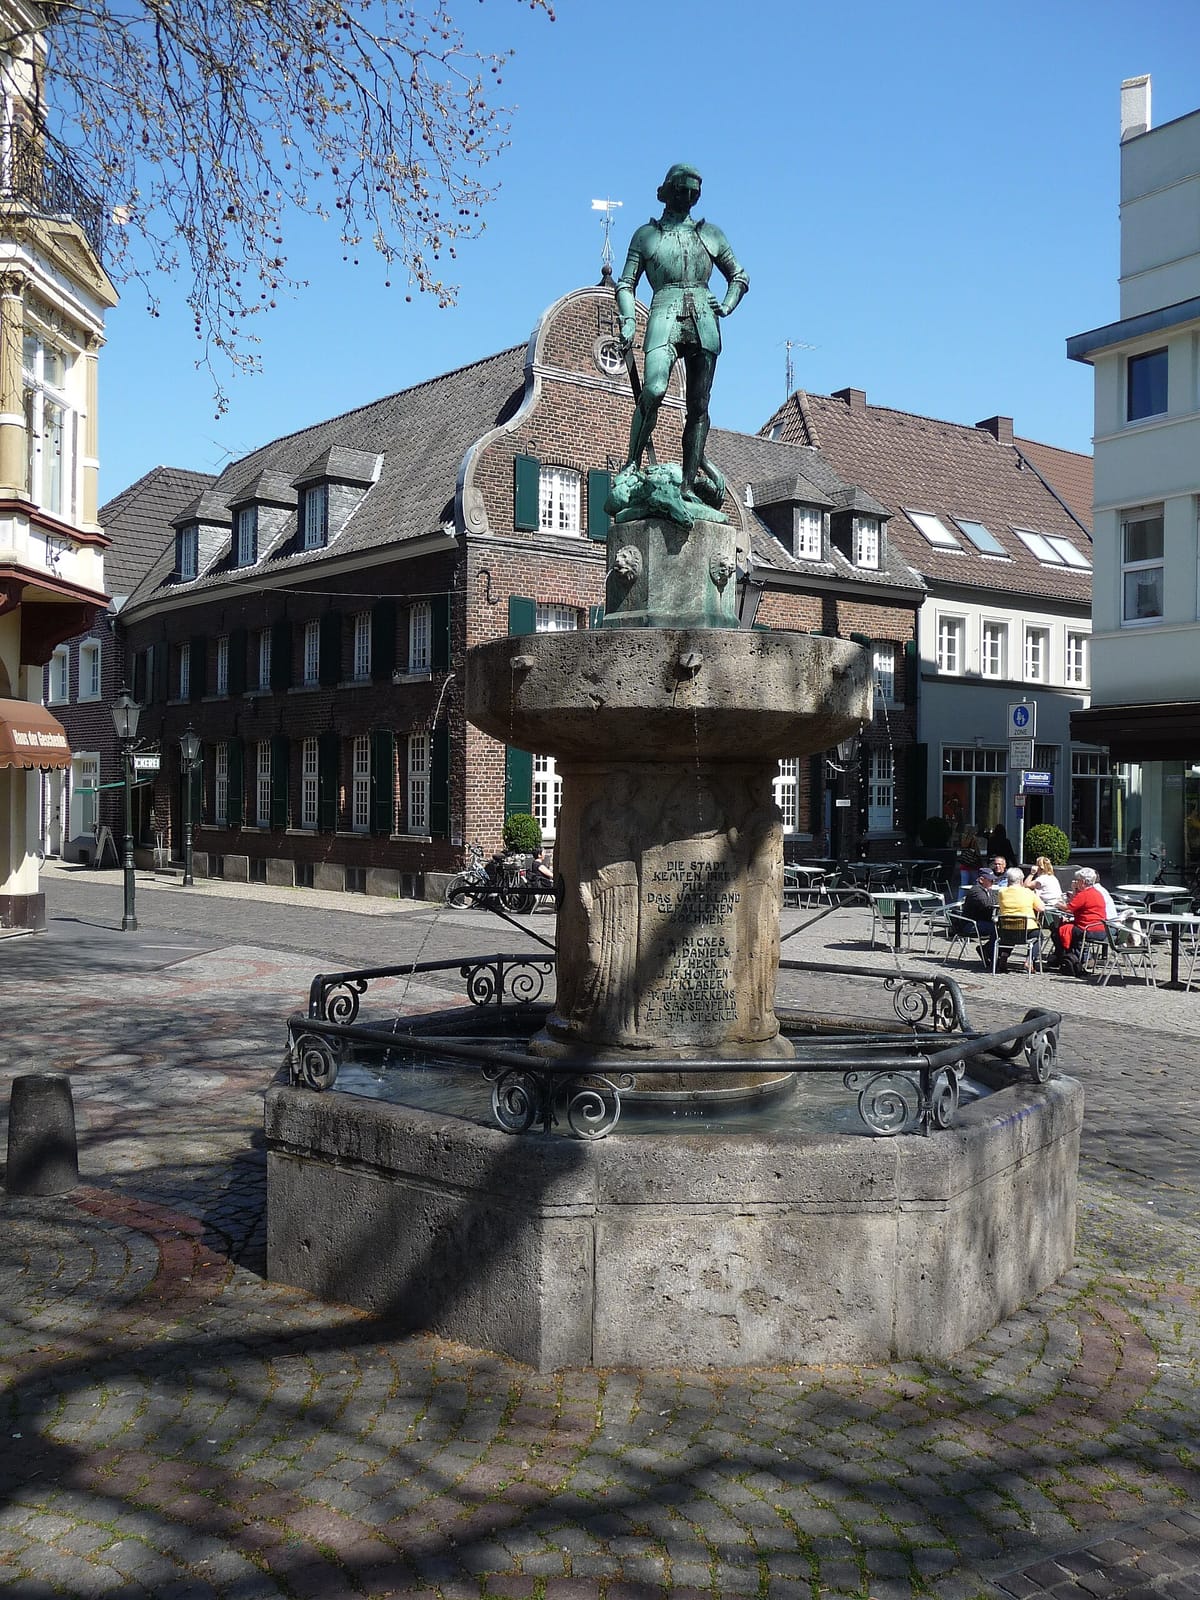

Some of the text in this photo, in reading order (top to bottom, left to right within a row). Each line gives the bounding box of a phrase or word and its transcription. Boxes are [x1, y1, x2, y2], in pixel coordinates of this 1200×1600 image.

[12, 729, 29, 745] Haus
[28, 730, 39, 746] der
[134, 758, 160, 768] CKEREI
[666, 861, 727, 871] DIE STADT
[648, 893, 740, 903] DAS VATERLAND
[658, 904, 733, 914] GEFALLENEN
[682, 937, 725, 947] RICKES
[664, 1001, 736, 1012] SASSENFELD
